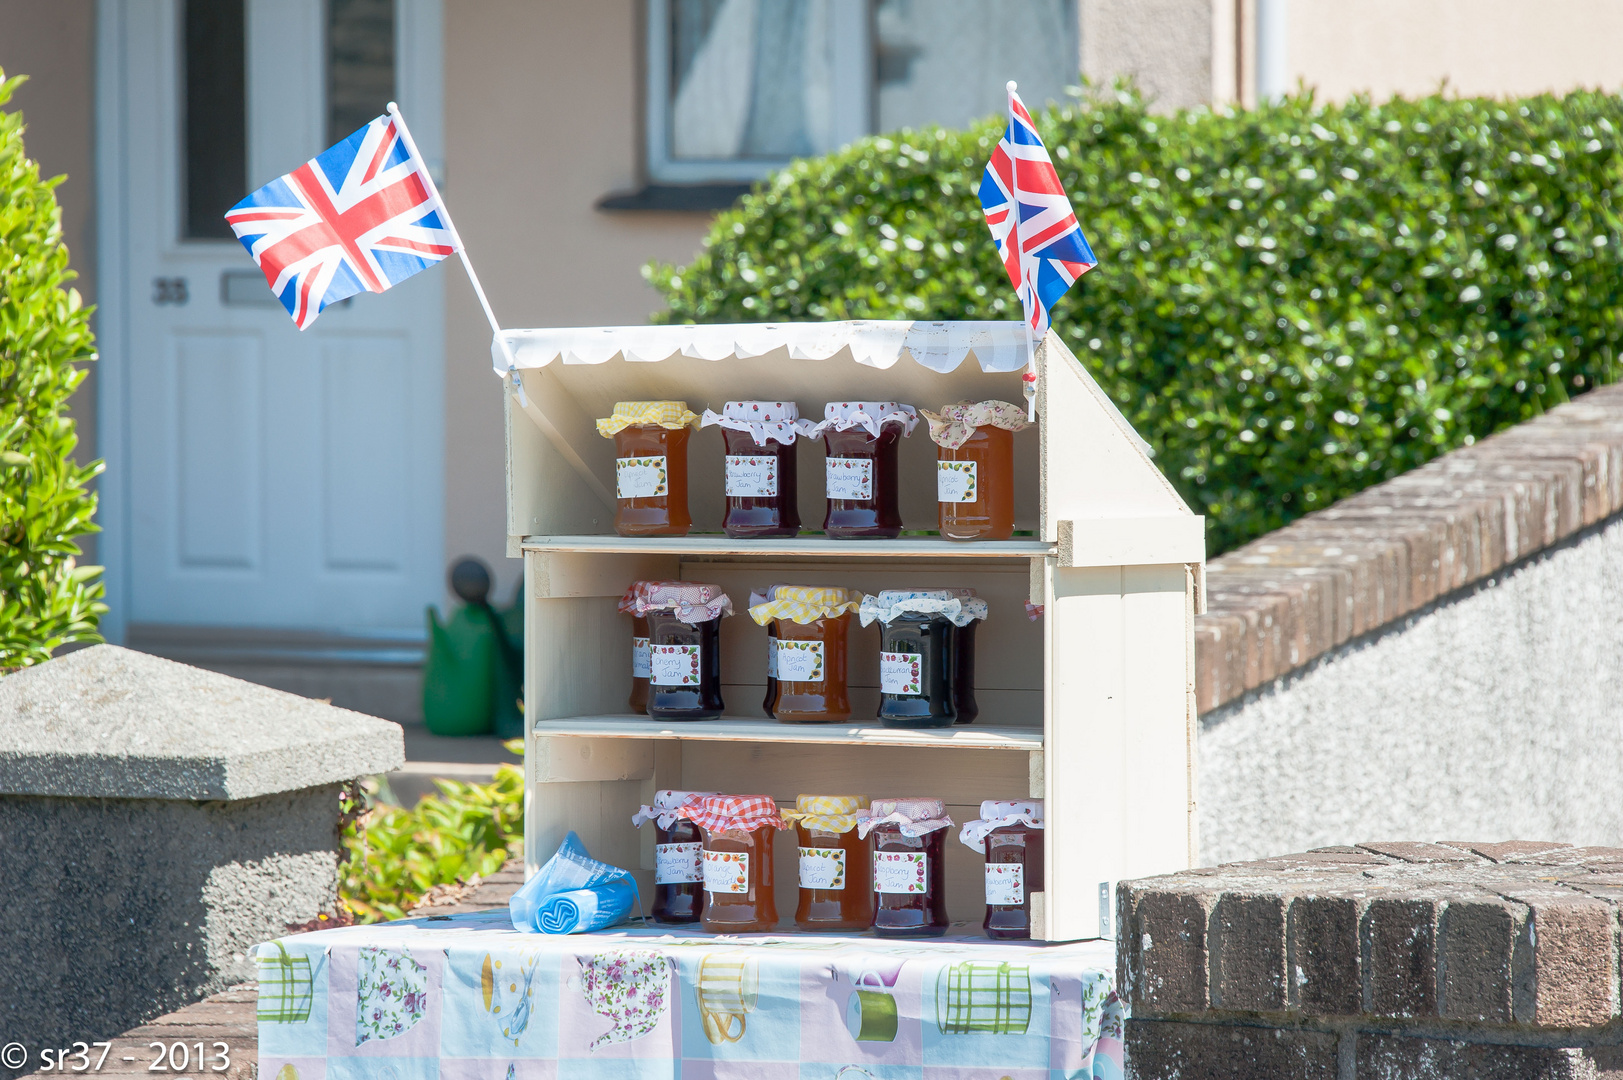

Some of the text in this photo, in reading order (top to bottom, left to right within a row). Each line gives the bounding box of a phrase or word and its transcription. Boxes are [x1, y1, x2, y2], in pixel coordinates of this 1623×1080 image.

[634, 476, 653, 488] Jam
[735, 479, 751, 488] Jam
[831, 481, 847, 494] Jam
[943, 483, 958, 495] Jam
[661, 665, 682, 678] Jam
[787, 661, 806, 673] Jam
[666, 865, 685, 877] Jam
[807, 872, 828, 884] Jam
[885, 876, 904, 889] Jam
